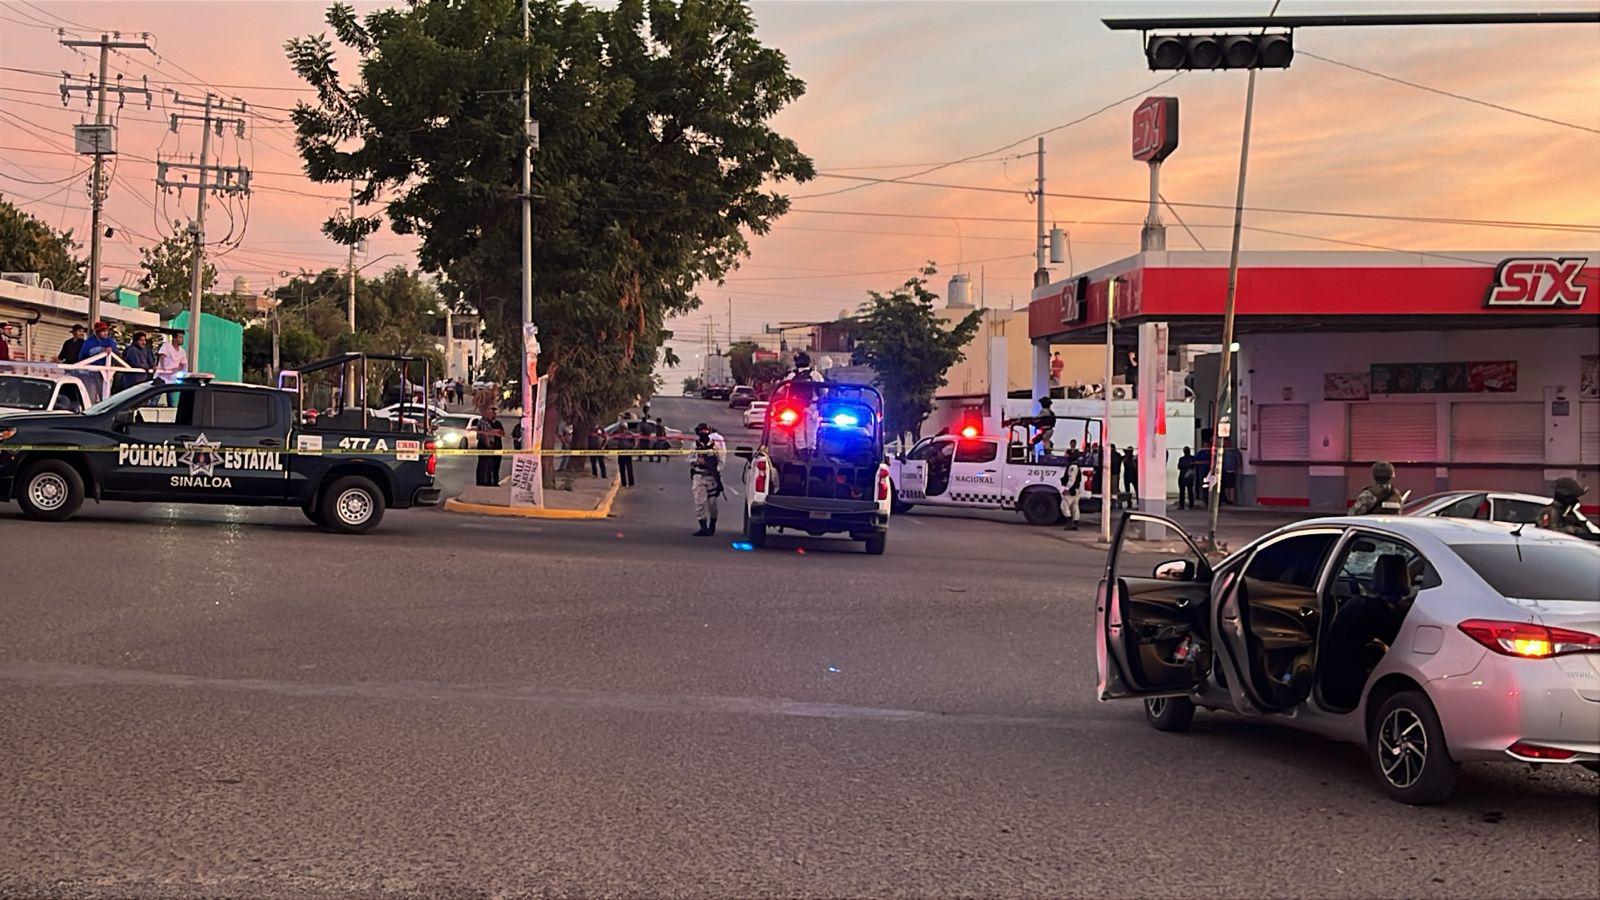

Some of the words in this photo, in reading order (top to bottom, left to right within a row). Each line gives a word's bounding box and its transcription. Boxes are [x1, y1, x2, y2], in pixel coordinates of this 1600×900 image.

[339, 437, 370, 450] 477
[374, 438, 388, 451] A
[118, 440, 177, 467] POLICÍA
[224, 448, 283, 471] ESTATAL
[170, 475, 232, 488] SINALOA
[954, 475, 994, 484] NACIONAL
